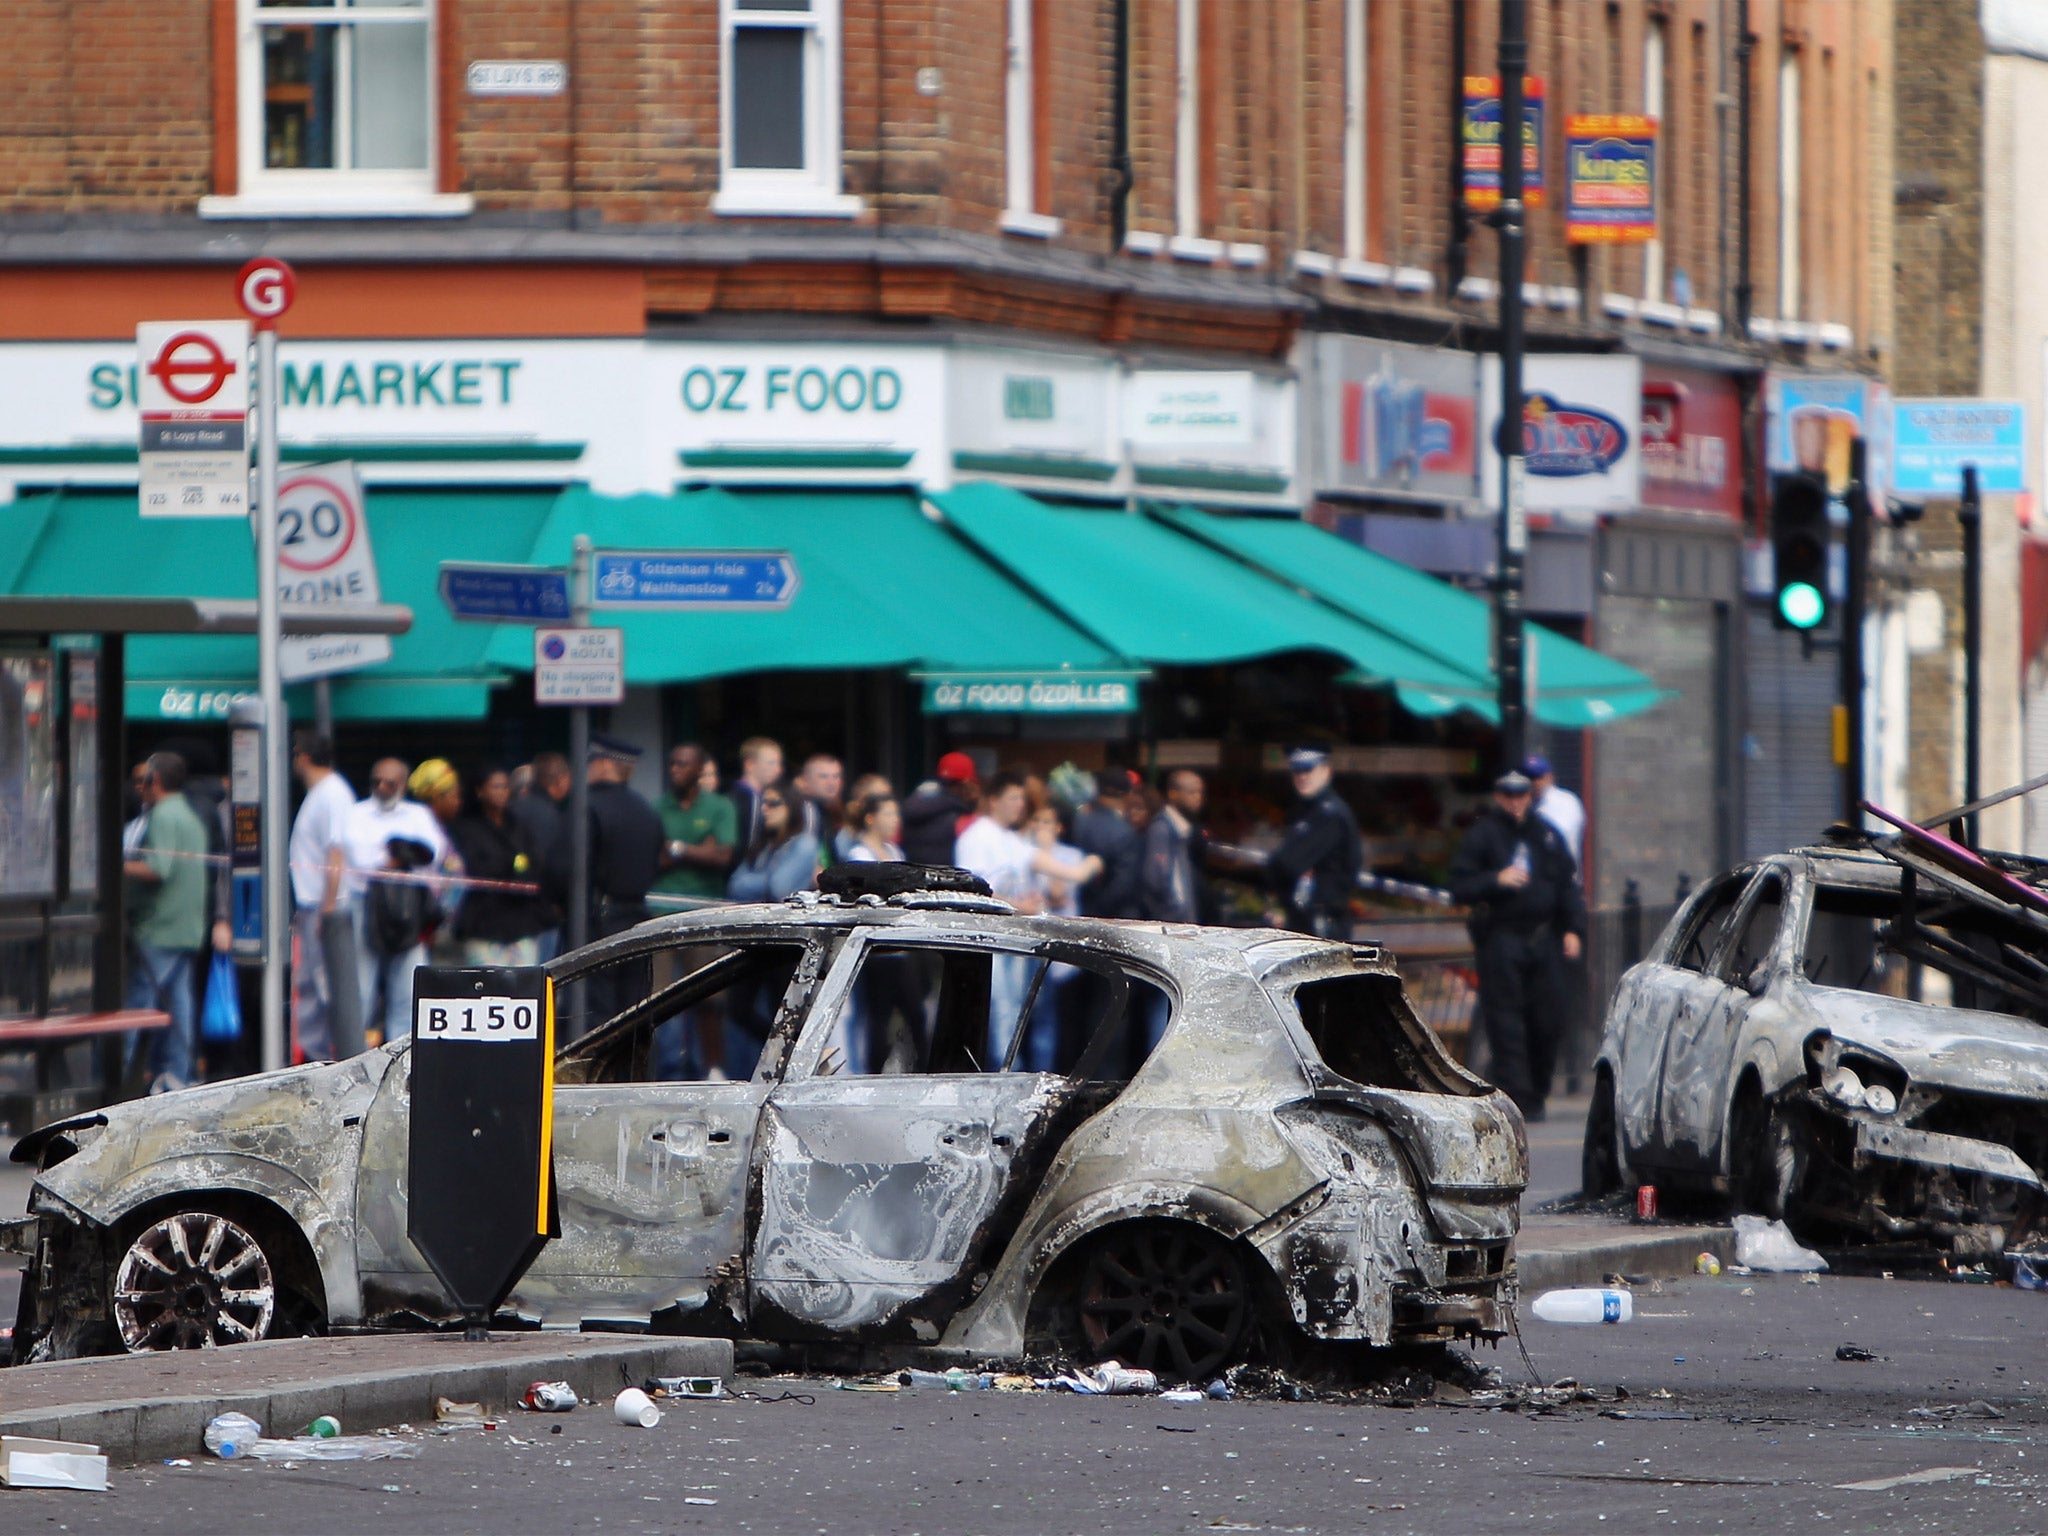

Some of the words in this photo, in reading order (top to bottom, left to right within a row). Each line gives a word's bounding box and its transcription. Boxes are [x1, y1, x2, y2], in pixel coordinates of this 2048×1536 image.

[1463, 113, 1536, 140] kins
[1578, 151, 1648, 183] kings
[243, 267, 285, 317] G
[681, 365, 748, 412] OZ
[765, 365, 902, 412] FOOD
[174, 430, 196, 443] Loys
[198, 430, 224, 441] Road
[181, 493, 205, 505] 243
[217, 493, 241, 505] W4
[279, 501, 341, 546] 20
[640, 561, 710, 576] Tottenham
[714, 562, 746, 576] Hale
[640, 580, 729, 596] Walthamstow
[579, 634, 607, 646] RED
[571, 647, 615, 659] ROUTE
[160, 687, 195, 716] ÖZ
[560, 686, 582, 698] any
[934, 679, 964, 705] ÖZ
[967, 683, 1026, 705] FOOD
